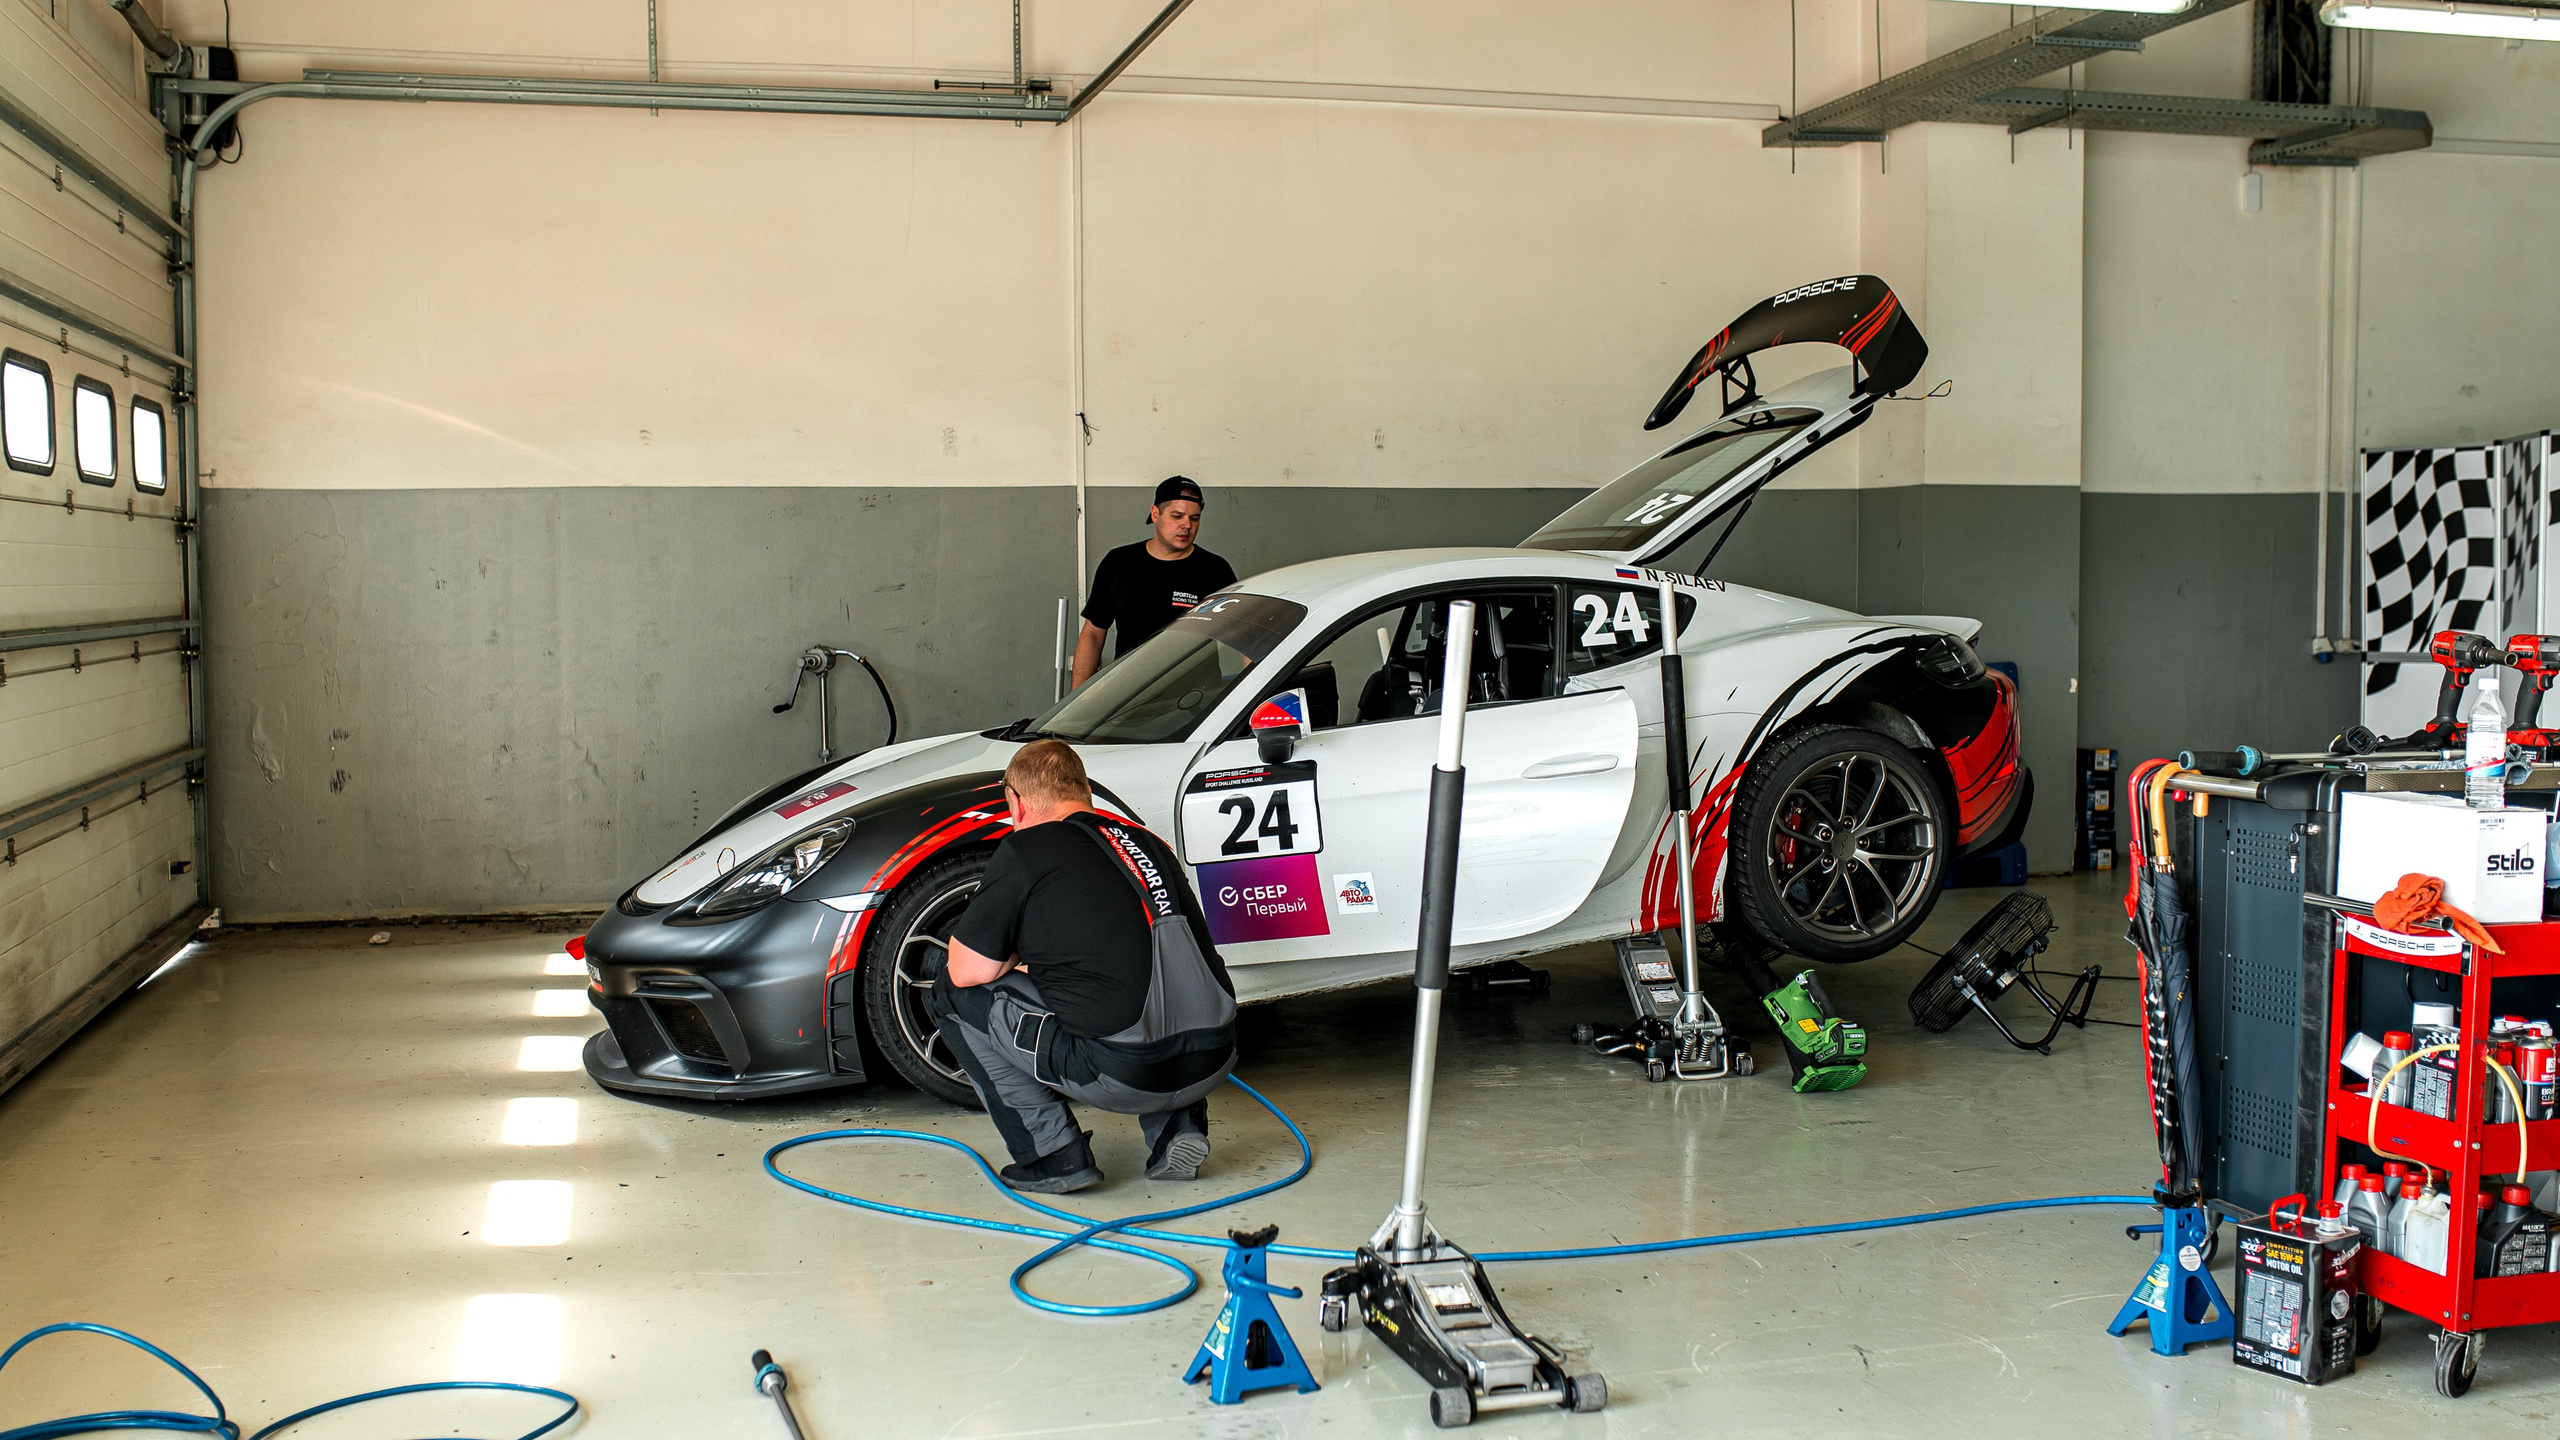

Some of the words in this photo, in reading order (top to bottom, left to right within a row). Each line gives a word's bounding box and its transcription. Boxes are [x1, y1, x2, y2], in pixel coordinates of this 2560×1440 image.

[1773, 277, 1858, 307] PORSCHE
[1624, 492, 1695, 525] 24
[1173, 591, 1198, 600] SPORTCAR
[1573, 591, 1650, 648] 24
[1205, 767, 1264, 779] PORSCHE
[1218, 789, 1299, 857] 24
[1111, 838, 1125, 855] WITH
[1108, 827, 1163, 888] SPORTCAR
[2487, 848, 2534, 872] Stilo
[1242, 884, 1288, 902] СБЕР
[1340, 889, 1361, 897] АВТО
[1346, 895, 1373, 903] РАДИО
[1246, 897, 1307, 917] Первый
[2370, 931, 2435, 951] PORSCHE
[2266, 1242, 2304, 1254] COMPETITION
[2266, 1248, 2279, 1260] SAE
[2279, 1251, 2304, 1265] 15W-50
[2266, 1258, 2290, 1273] MOTOR
[2291, 1265, 2303, 1276] OIL
